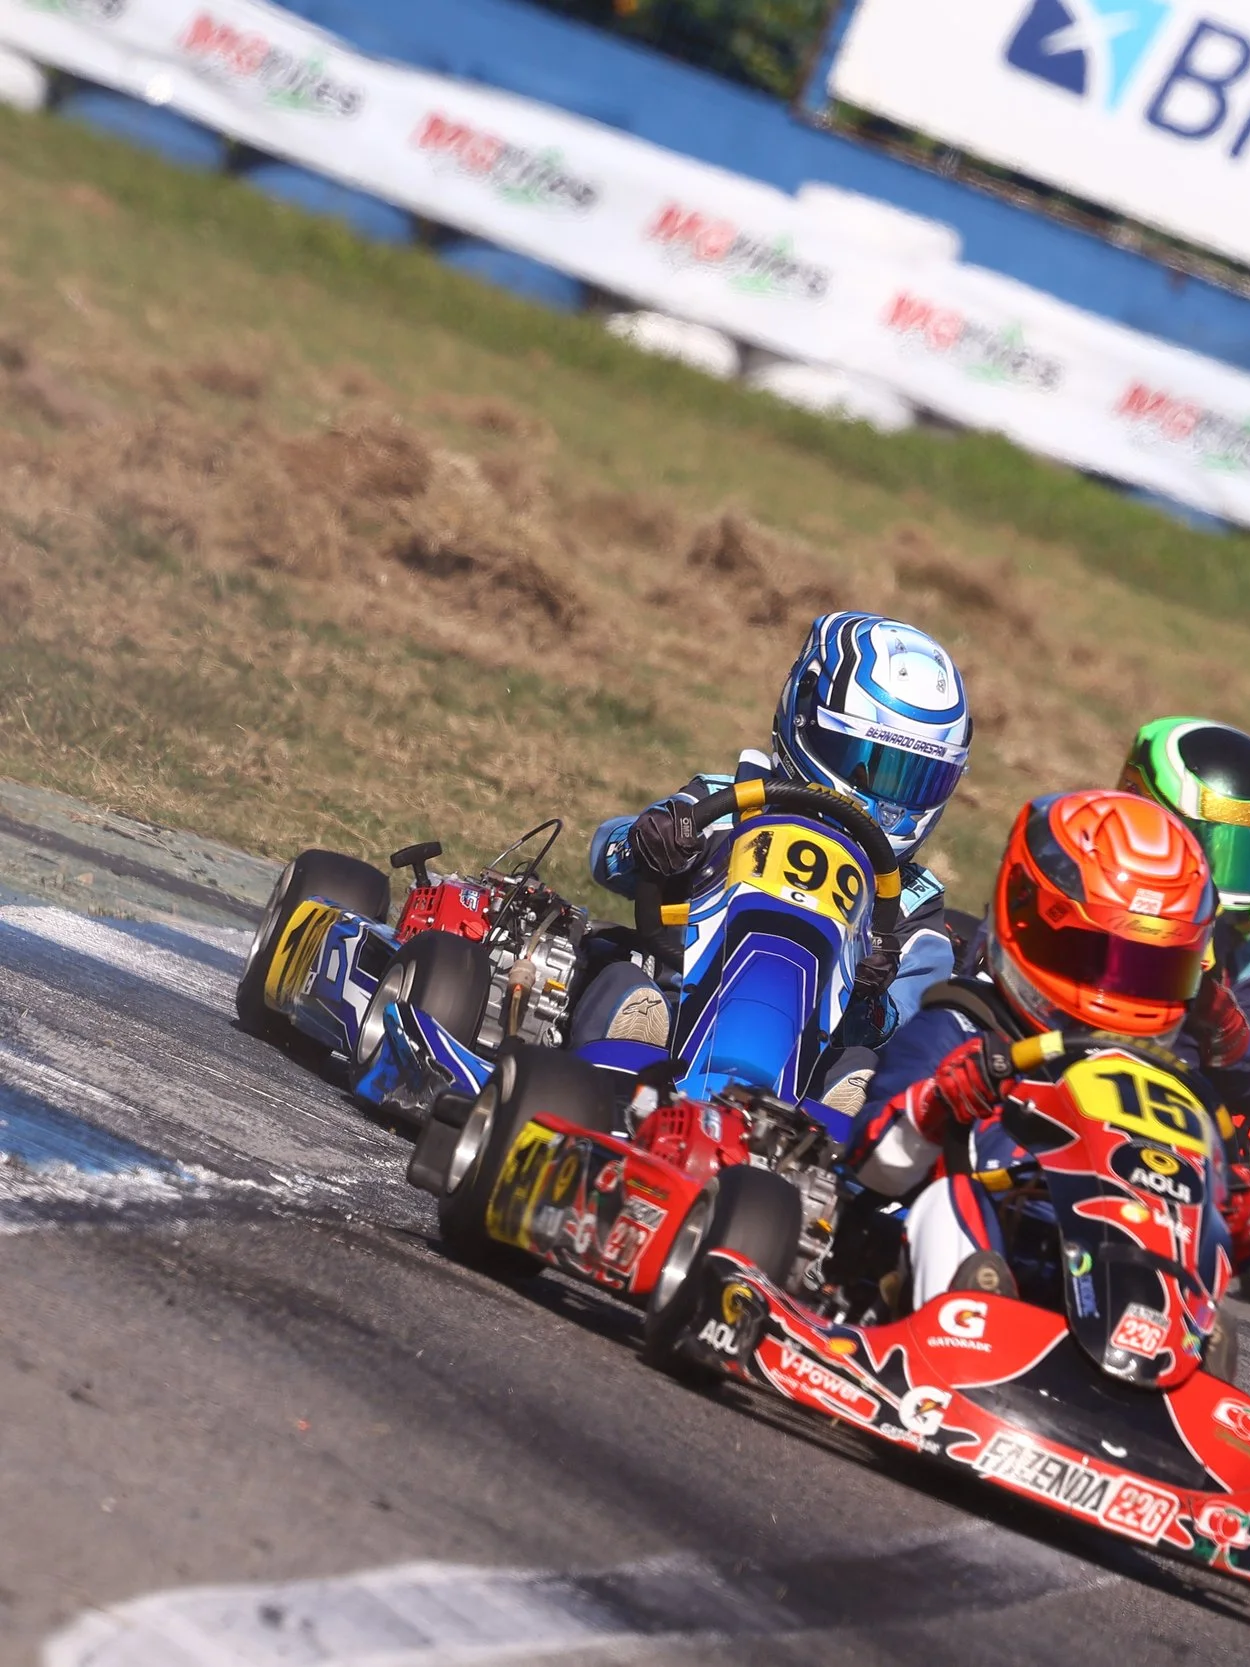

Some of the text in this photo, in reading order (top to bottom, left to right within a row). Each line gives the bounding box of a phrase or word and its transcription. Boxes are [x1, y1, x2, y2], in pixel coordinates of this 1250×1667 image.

[865, 726, 914, 748] BERNARDO
[744, 831, 864, 920] 199
[1093, 1070, 1204, 1143] 15
[938, 1298, 989, 1338] G
[1118, 1319, 1162, 1351] 226
[926, 1336, 992, 1353] GATORADE
[780, 1347, 866, 1402] V-Power
[899, 1385, 953, 1436] G
[978, 1434, 1171, 1534] FAZENDA 226
